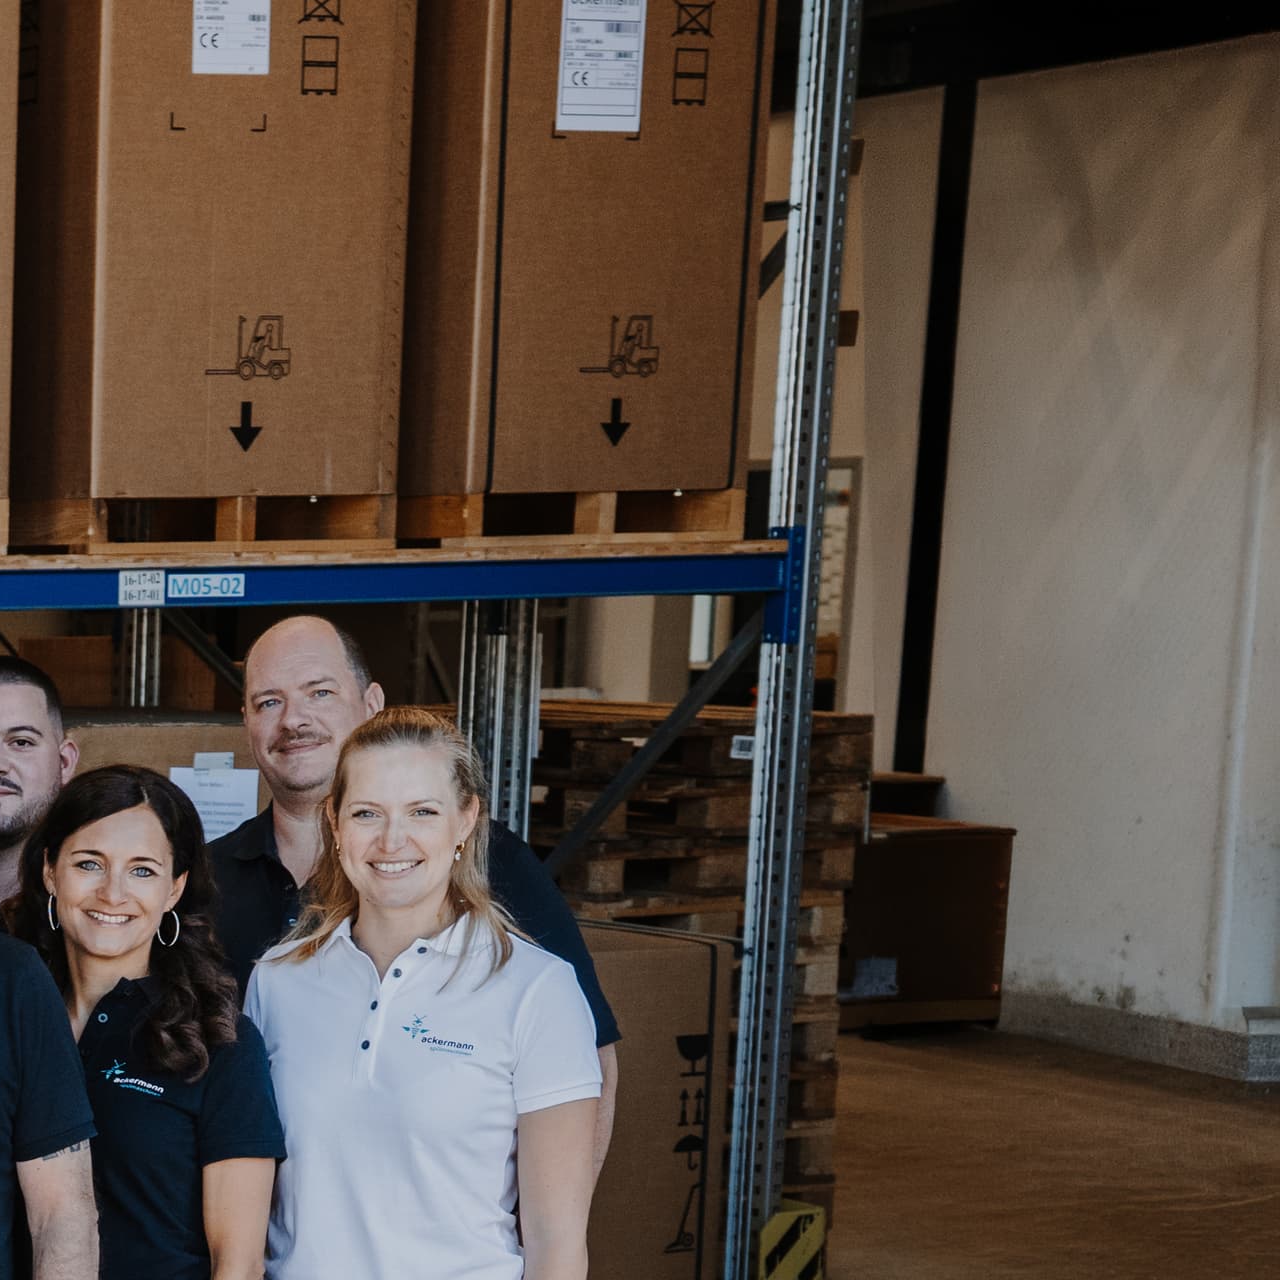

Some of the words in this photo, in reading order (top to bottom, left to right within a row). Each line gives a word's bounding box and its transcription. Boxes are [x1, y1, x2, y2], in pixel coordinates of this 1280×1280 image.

[170, 577, 242, 596] M05-02
[421, 1036, 474, 1051] ackermann
[113, 1077, 165, 1094] ackermann
